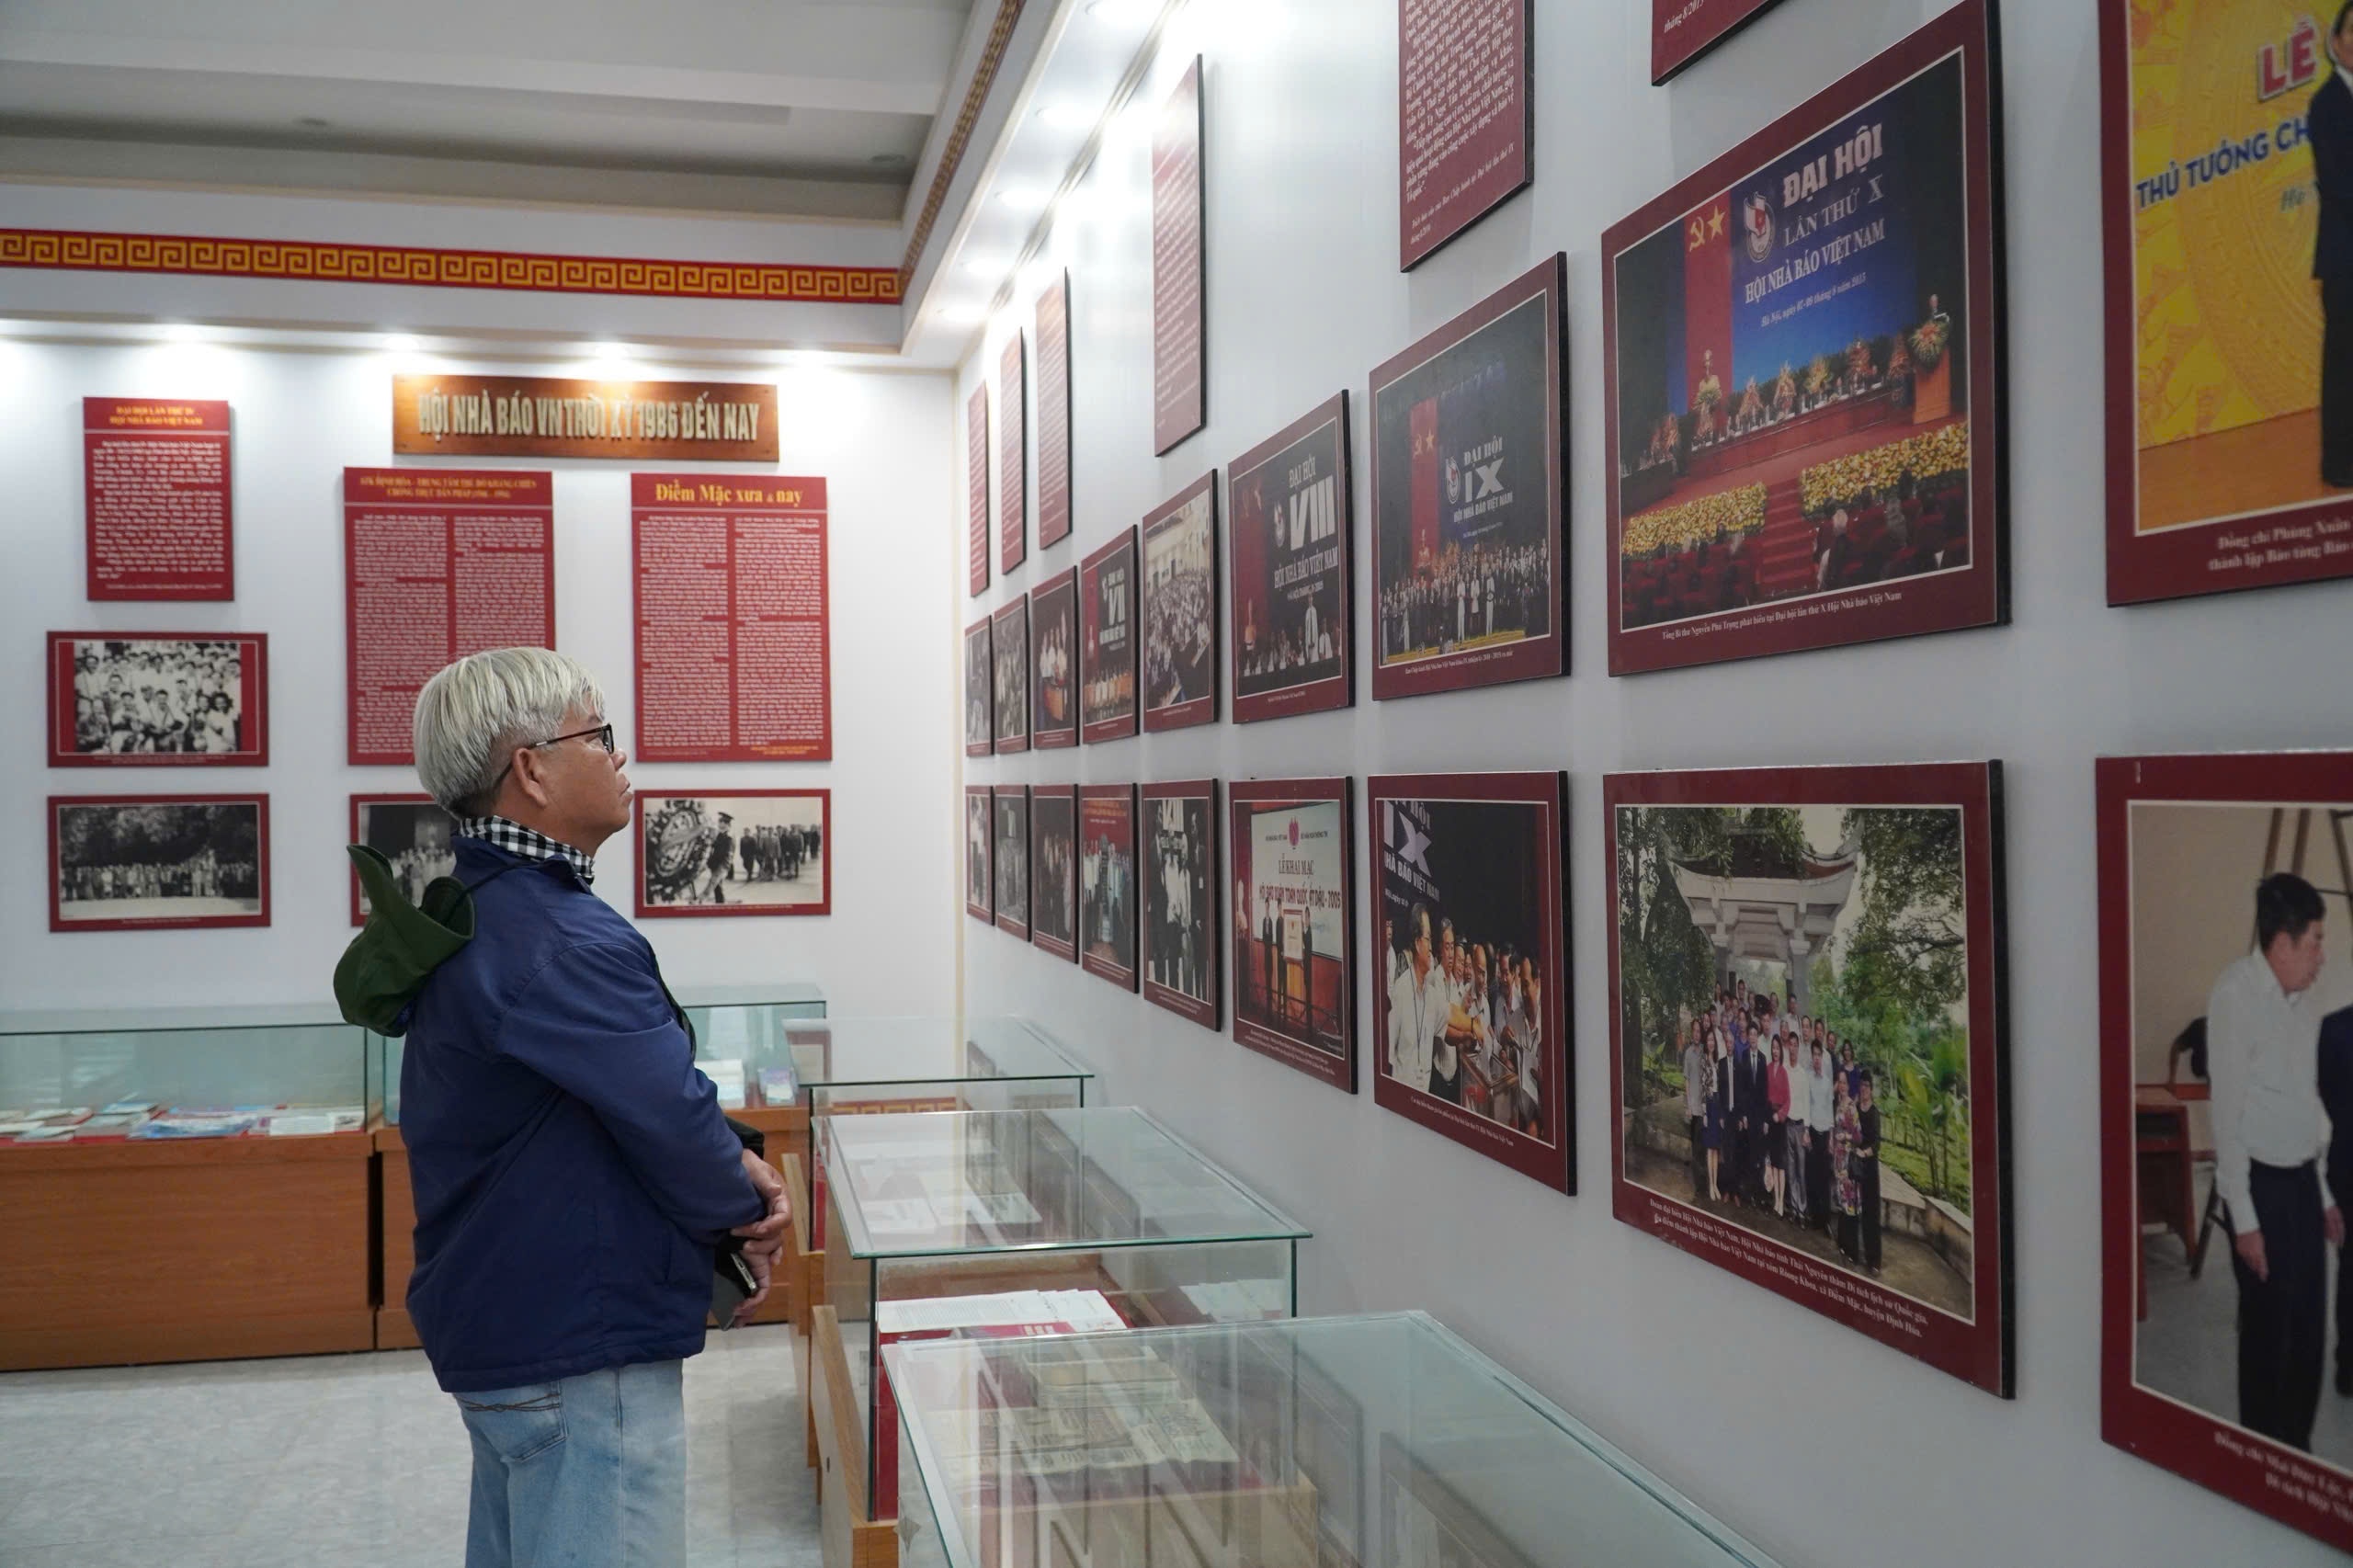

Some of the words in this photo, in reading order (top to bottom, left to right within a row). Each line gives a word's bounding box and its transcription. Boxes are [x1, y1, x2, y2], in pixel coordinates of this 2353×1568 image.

[1783, 154, 1828, 208] ĐẠI
[1834, 123, 1882, 180] HỘI
[2136, 160, 2179, 208] THỦ
[1785, 212, 1818, 246] LẦN
[1822, 187, 1860, 228] THỨ
[1868, 174, 1884, 203] X
[1745, 274, 1767, 303] HỘI
[1768, 259, 1792, 293] NHÀ
[1794, 249, 1820, 280] BÁO
[1822, 235, 1851, 265] VIỆT
[1852, 219, 1885, 253] NAM
[418, 387, 449, 442] HỘI
[453, 388, 494, 435] NHÀ
[495, 389, 534, 436] BÁO
[536, 398, 563, 437] VN
[565, 392, 606, 439] THỜI
[609, 393, 634, 440] KỲ
[636, 401, 678, 439] 1986
[681, 391, 721, 440] ĐẾN
[723, 403, 761, 441] NAY
[1463, 446, 1482, 468] ĐẠI
[1465, 458, 1504, 503] IX
[655, 478, 695, 501] Điềm
[699, 483, 732, 506] Mặc
[735, 489, 763, 503] xưa
[776, 489, 803, 507] nay
[1290, 474, 1336, 551] VIII
